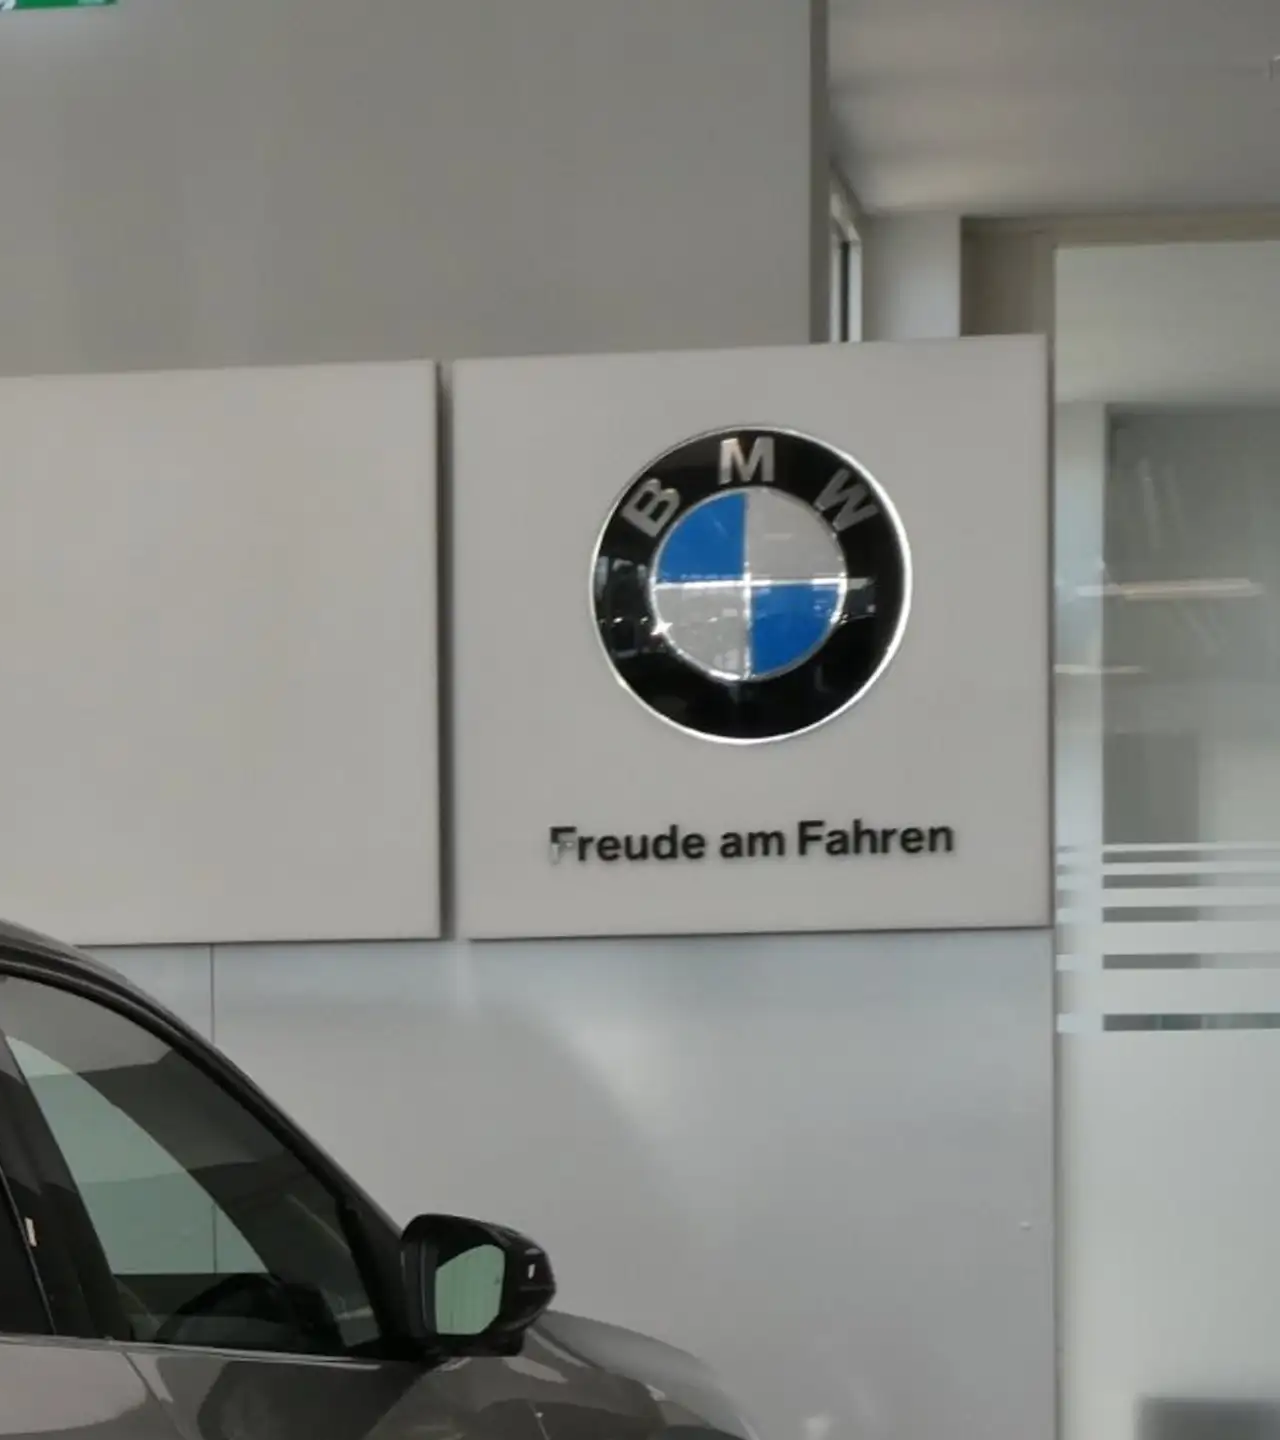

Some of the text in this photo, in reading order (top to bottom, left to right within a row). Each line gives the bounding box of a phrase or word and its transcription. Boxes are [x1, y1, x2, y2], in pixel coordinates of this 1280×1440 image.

[621, 437, 878, 538] BMW
[549, 819, 955, 864] Freude am Fahren
